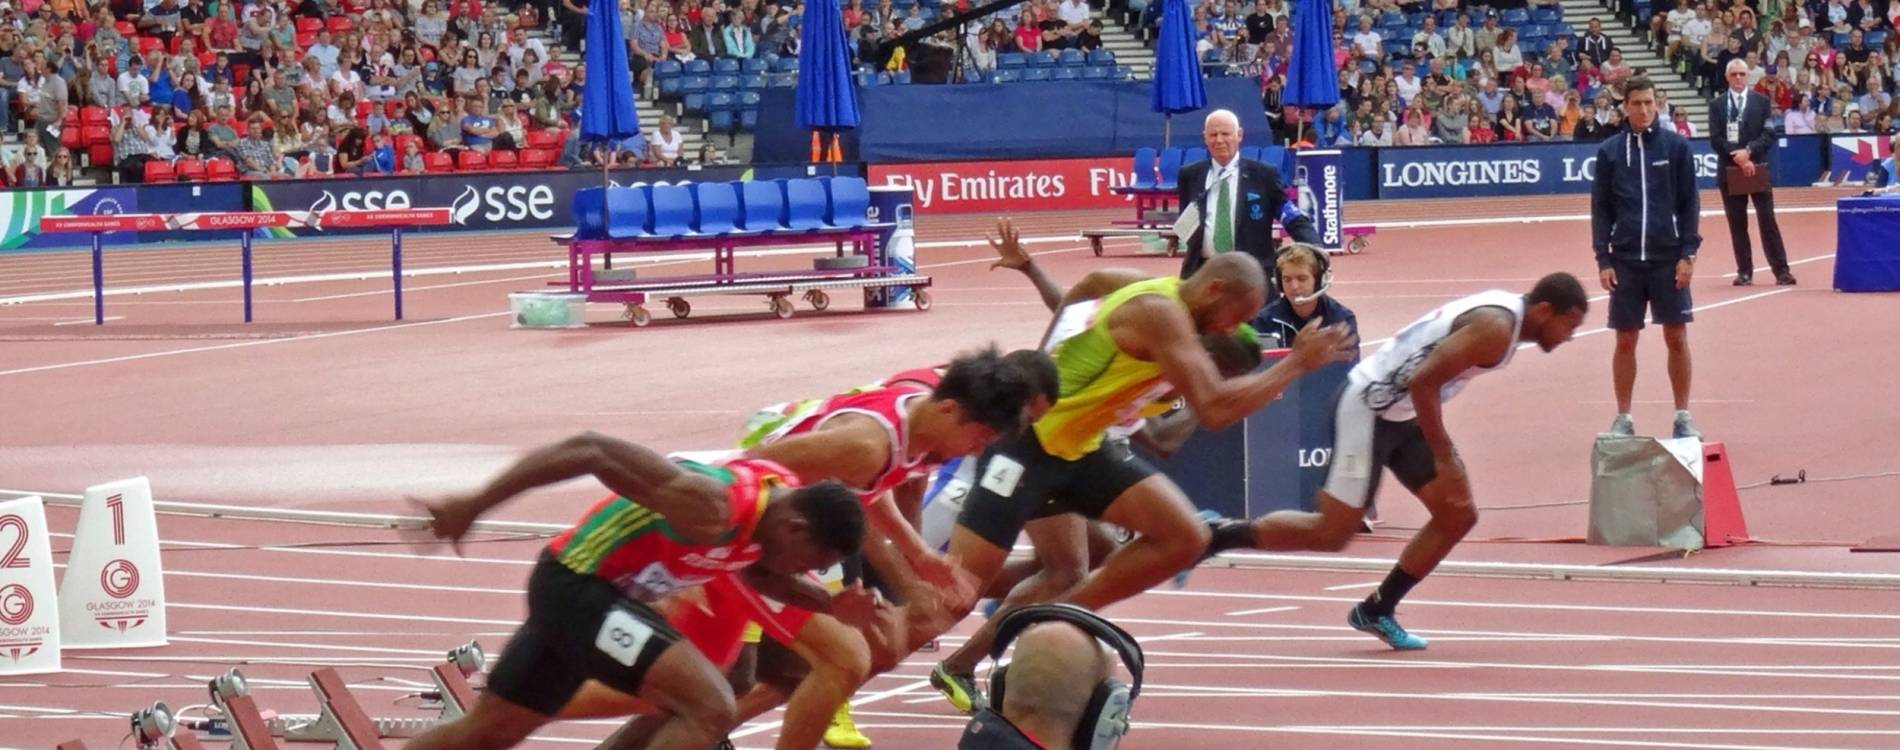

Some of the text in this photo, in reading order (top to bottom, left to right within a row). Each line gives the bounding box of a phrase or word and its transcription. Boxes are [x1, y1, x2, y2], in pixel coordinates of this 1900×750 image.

[940, 170, 1065, 201] Emirates
[1089, 168, 1138, 201] Fly
[1383, 159, 1541, 187] LONGINES
[484, 184, 555, 222] sse
[1322, 164, 1339, 245] Strathmore
[210, 215, 276, 225] GLASGOW 2014
[992, 467, 1009, 485] 4
[106, 493, 125, 545] 1
[0, 514, 31, 568] 2
[86, 599, 156, 611] GLASGOW 2014
[31, 626, 50, 636] 2014
[610, 627, 635, 648] 8
